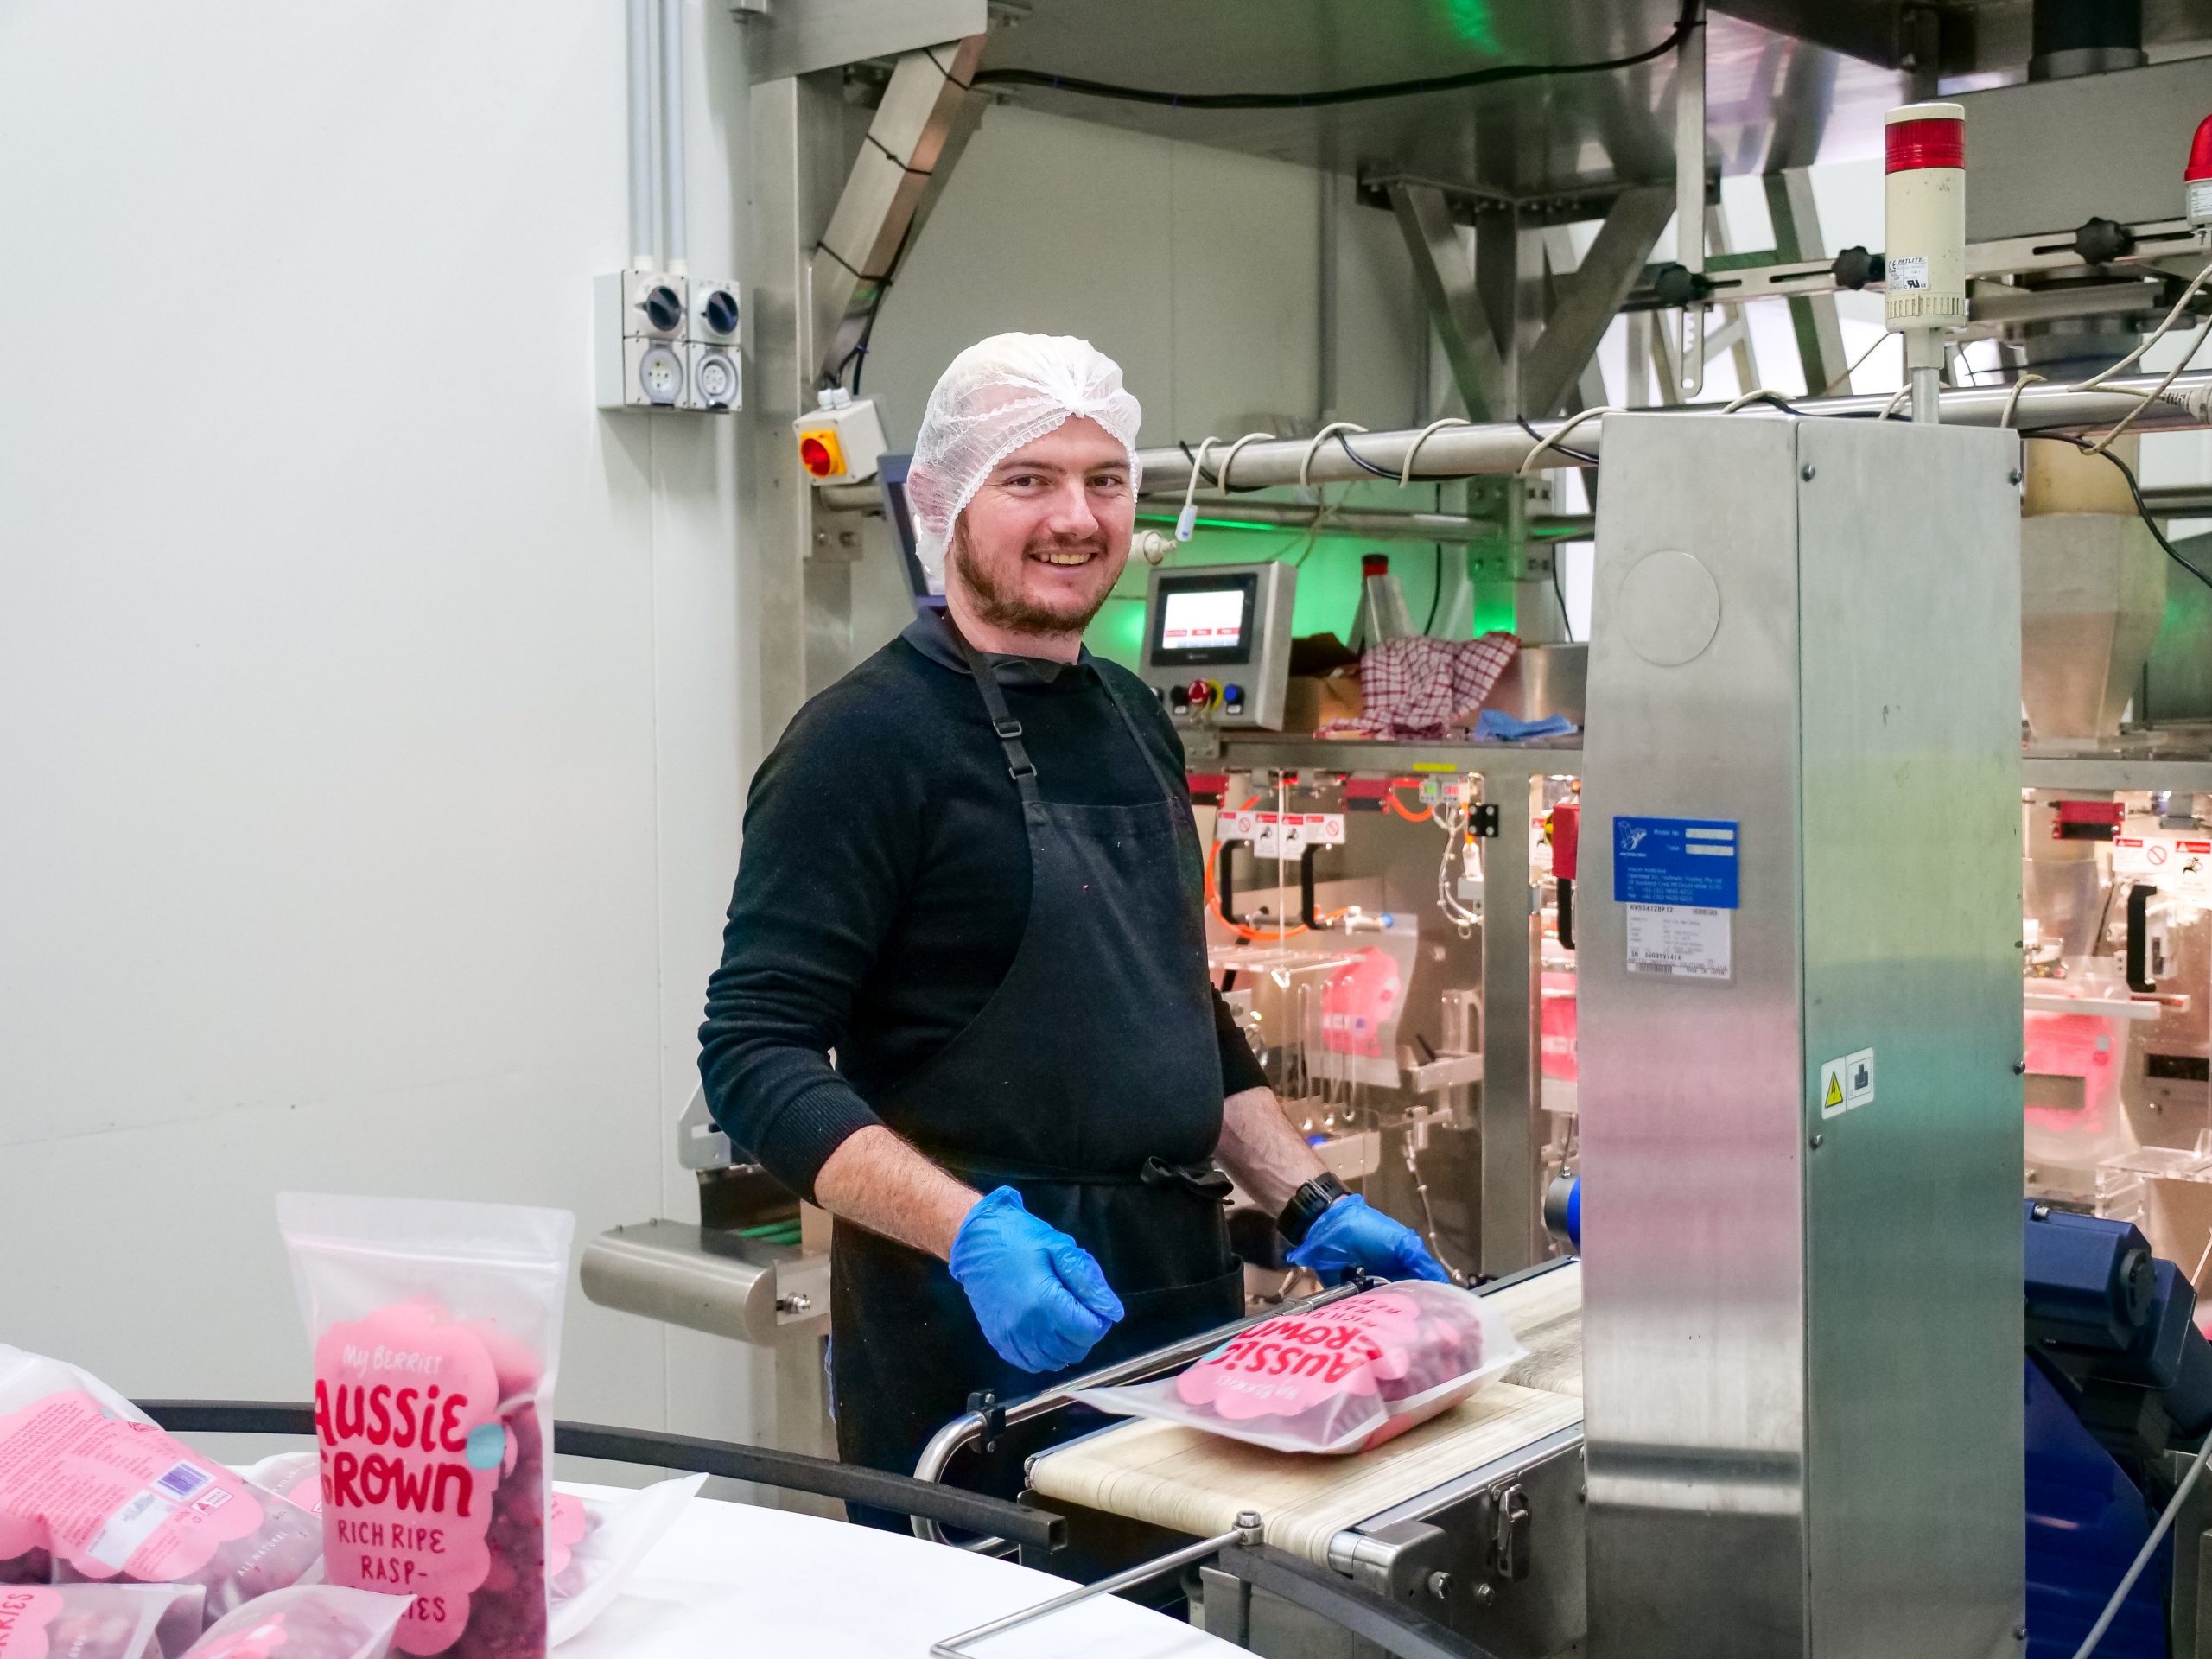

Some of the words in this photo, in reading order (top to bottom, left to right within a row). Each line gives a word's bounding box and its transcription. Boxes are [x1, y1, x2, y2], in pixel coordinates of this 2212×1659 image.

[236, 1560, 255, 1578] ALL
[251, 1530, 290, 1561] NATURAL
[337, 1519, 385, 1547] RICH
[391, 1522, 447, 1554] RIPE
[360, 1554, 429, 1585] RASP-
